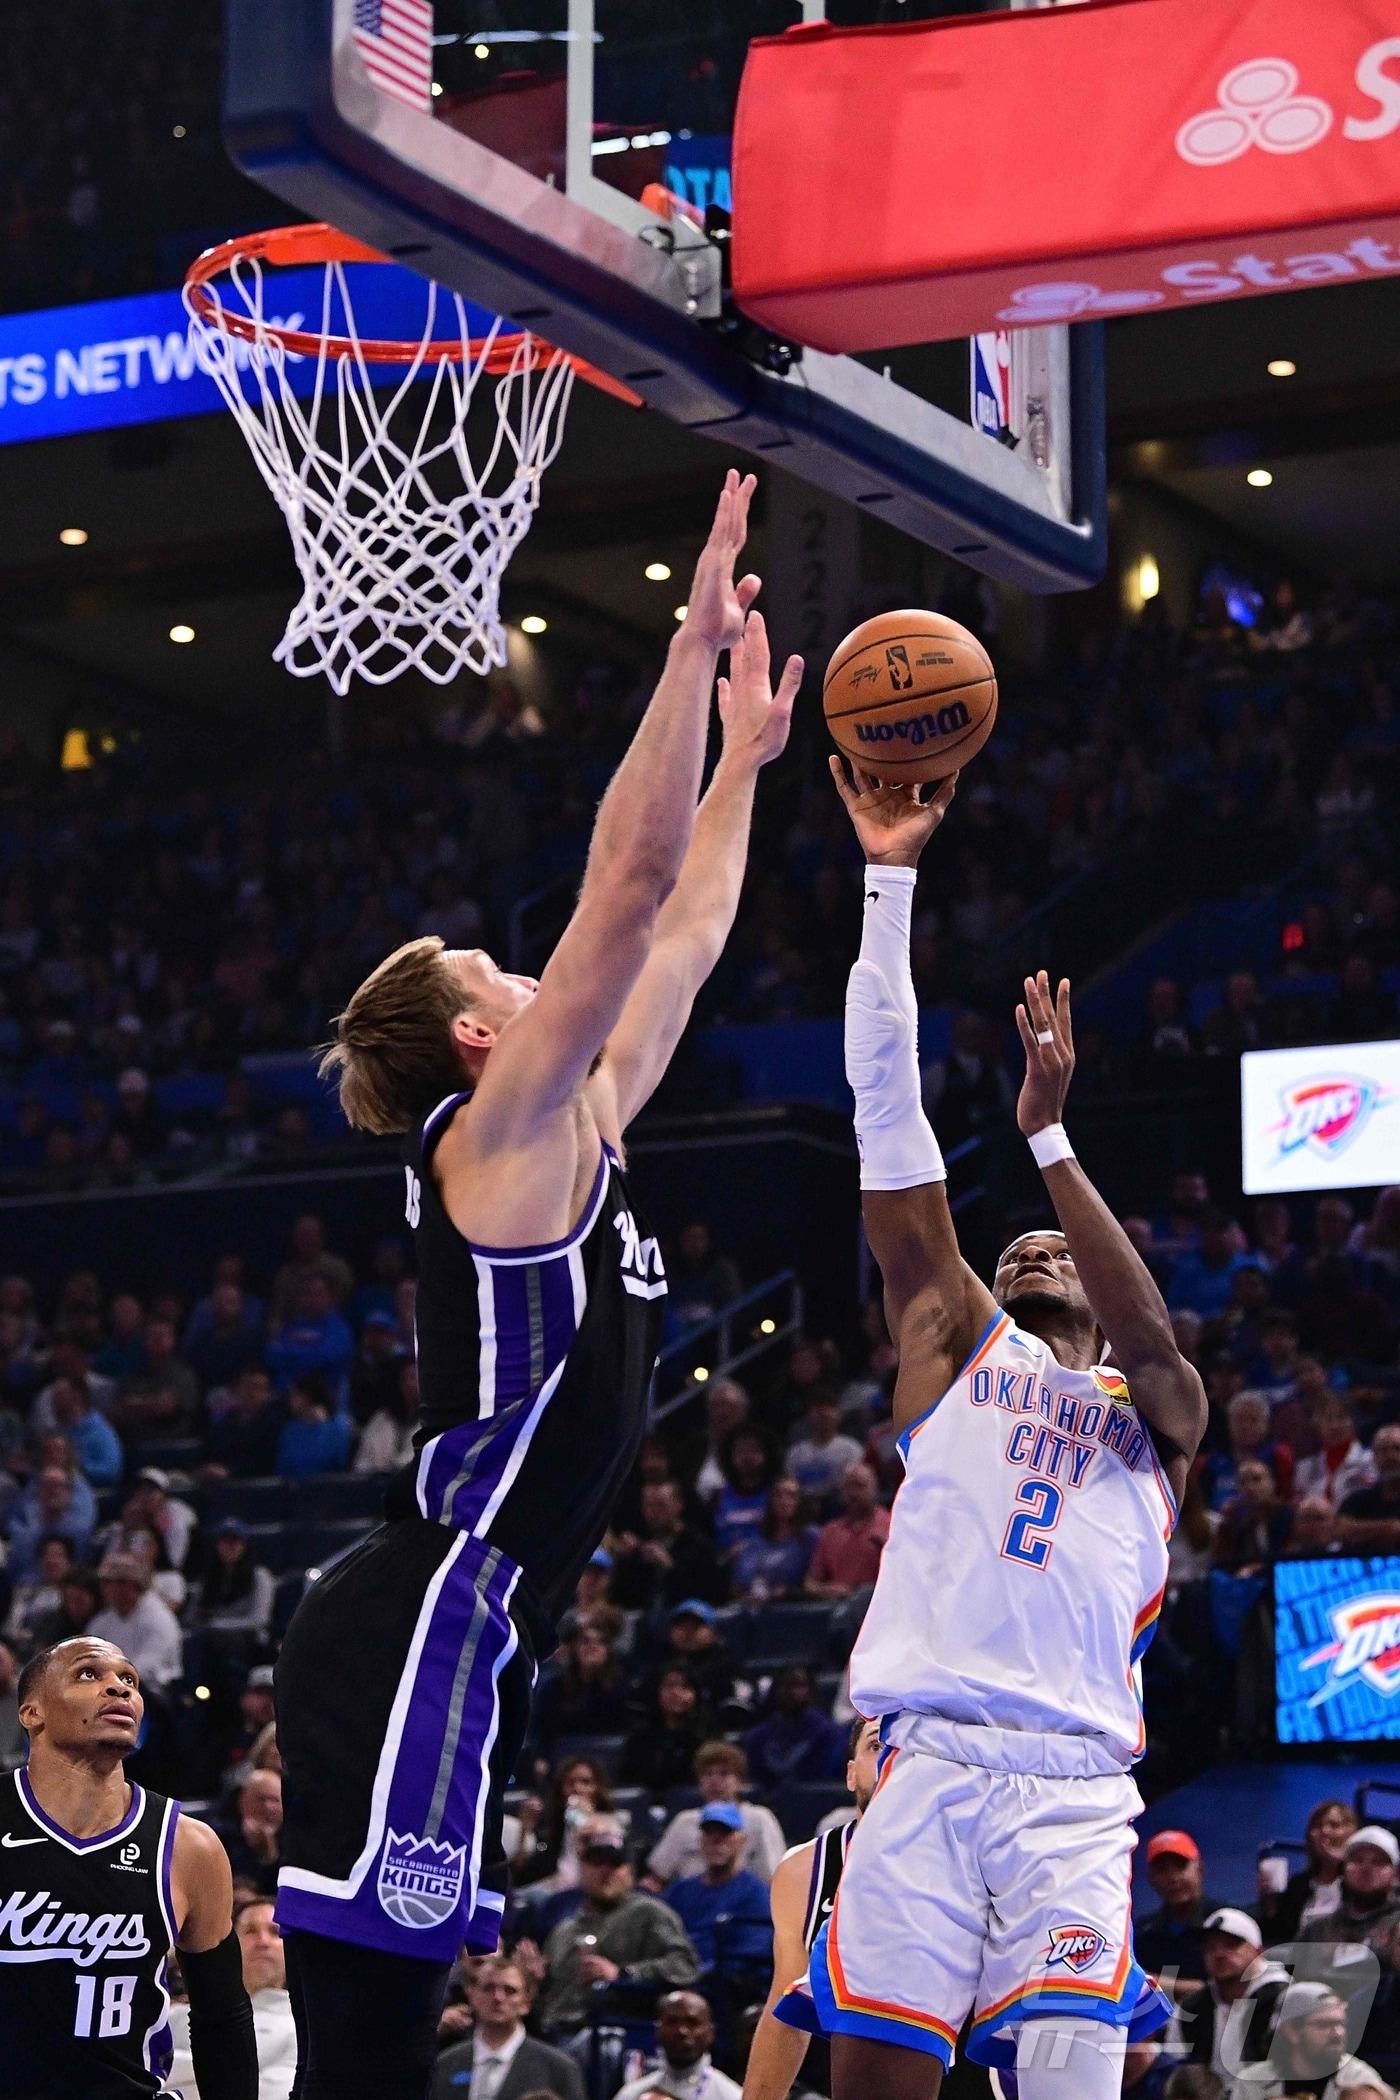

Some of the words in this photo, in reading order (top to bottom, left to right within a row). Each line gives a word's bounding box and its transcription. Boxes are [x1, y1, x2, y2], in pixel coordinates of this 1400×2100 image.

[1161, 235, 1400, 300] Stat
[854, 700, 972, 745] Wilson
[969, 1366, 1149, 1473] OKLAHOMA
[1006, 1420, 1098, 1489] CITY
[1000, 1476, 1065, 1572] 2
[381, 1867, 459, 1900] KINGS
[387, 1856, 460, 1879] SACRAMENTO
[0, 1891, 151, 1967] Kings
[1045, 1934, 1097, 1964] OKC
[74, 1975, 138, 2038] 18
